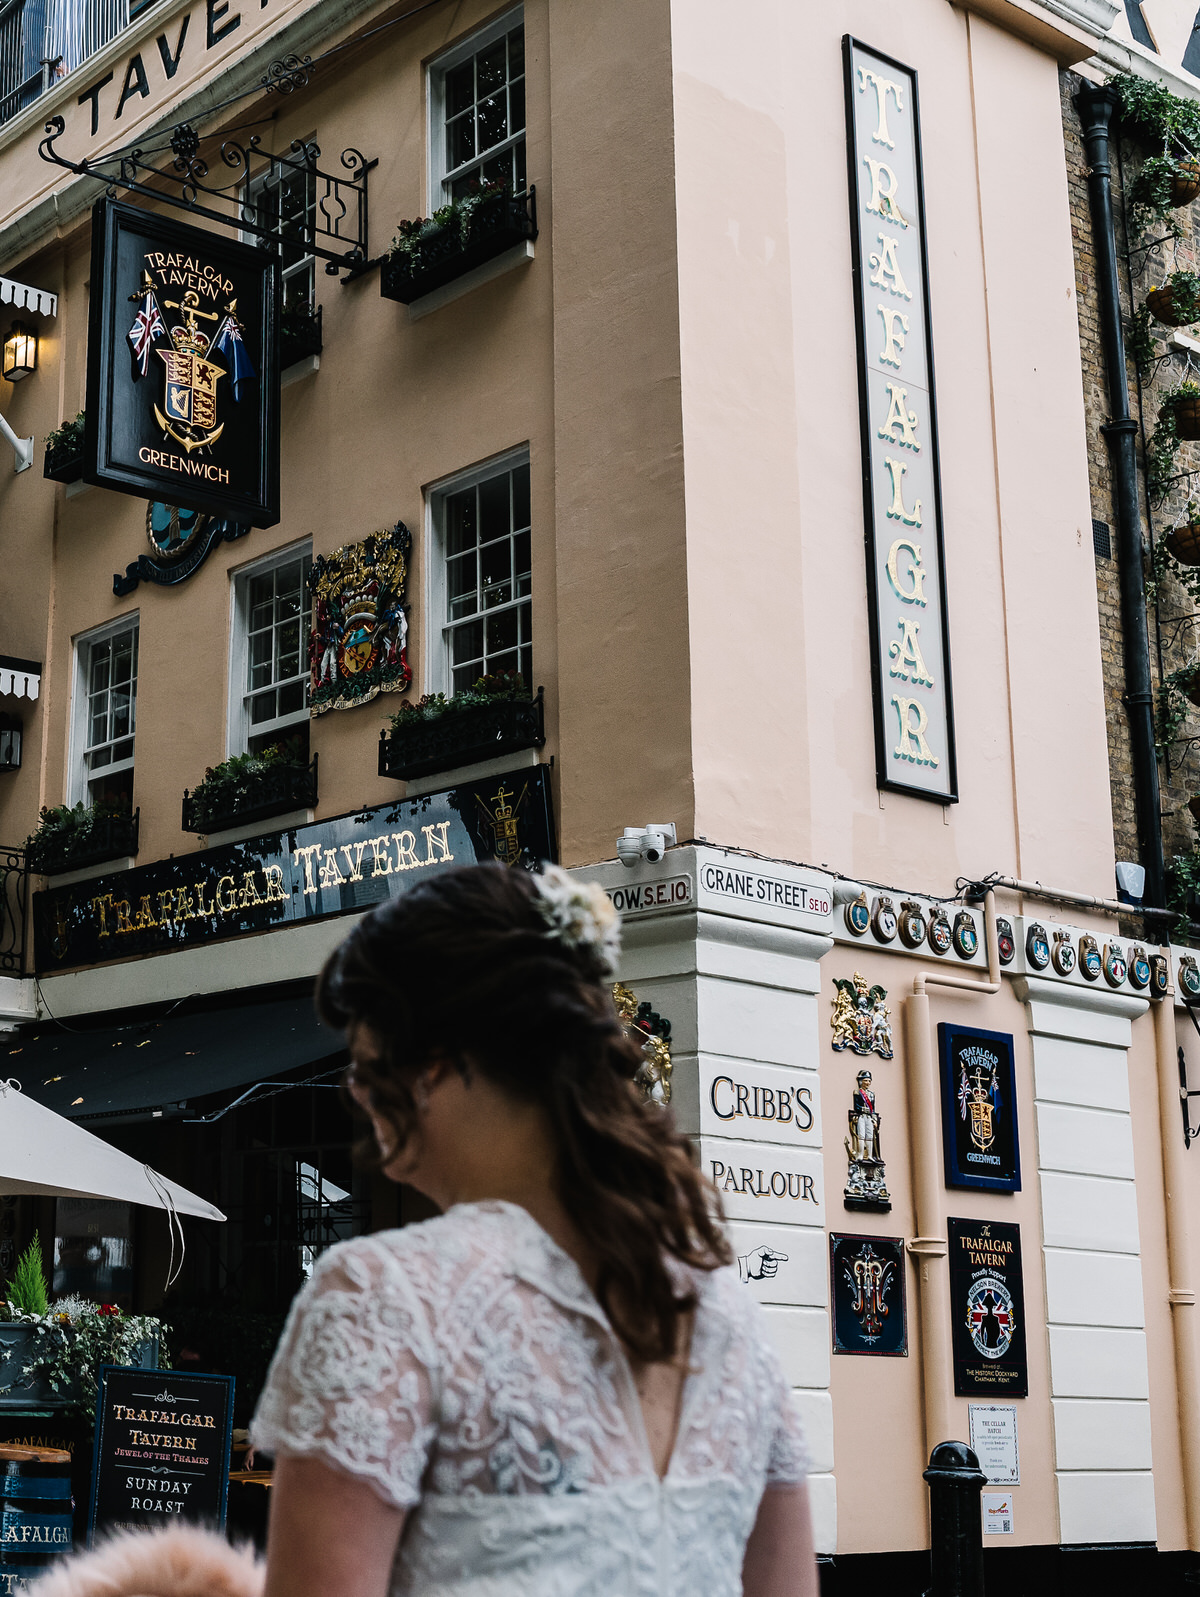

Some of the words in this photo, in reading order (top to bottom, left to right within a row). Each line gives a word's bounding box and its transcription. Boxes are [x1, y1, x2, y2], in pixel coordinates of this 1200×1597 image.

[77, 0, 268, 137] TAVE
[144, 252, 234, 296] TRAFALGAR
[156, 269, 219, 301] TAVERN
[858, 64, 940, 769] TRAFALGAR
[138, 446, 230, 484] GREENWICH
[92, 863, 291, 937] TRAFALGAR
[294, 821, 454, 892] TAVERN
[706, 867, 754, 898] CRANE
[757, 879, 808, 909] STREET
[809, 898, 829, 913] SE10
[959, 1046, 999, 1067] TRAFALGAR
[965, 1055, 993, 1071] TAVERN
[710, 1075, 815, 1132] CRIBB'S
[967, 1152, 1001, 1166] GREENWICH
[710, 1160, 820, 1205] PARLOUR
[980, 1225, 992, 1238] The
[959, 1236, 1014, 1254] TRAFALGAR
[969, 1251, 1006, 1267] TAVERN
[971, 1268, 988, 1280] Proudly
[988, 1268, 1007, 1283] Support
[970, 1280, 988, 1298] NELSON
[113, 1404, 216, 1428] TRAFALGAR
[129, 1429, 198, 1450] TAVERN
[114, 1447, 142, 1458] JEWEL
[143, 1451, 154, 1459] OF
[154, 1452, 171, 1461] THE
[172, 1453, 210, 1465] THAMES
[125, 1476, 193, 1495] SUNDAY
[131, 1497, 185, 1513] ROAST
